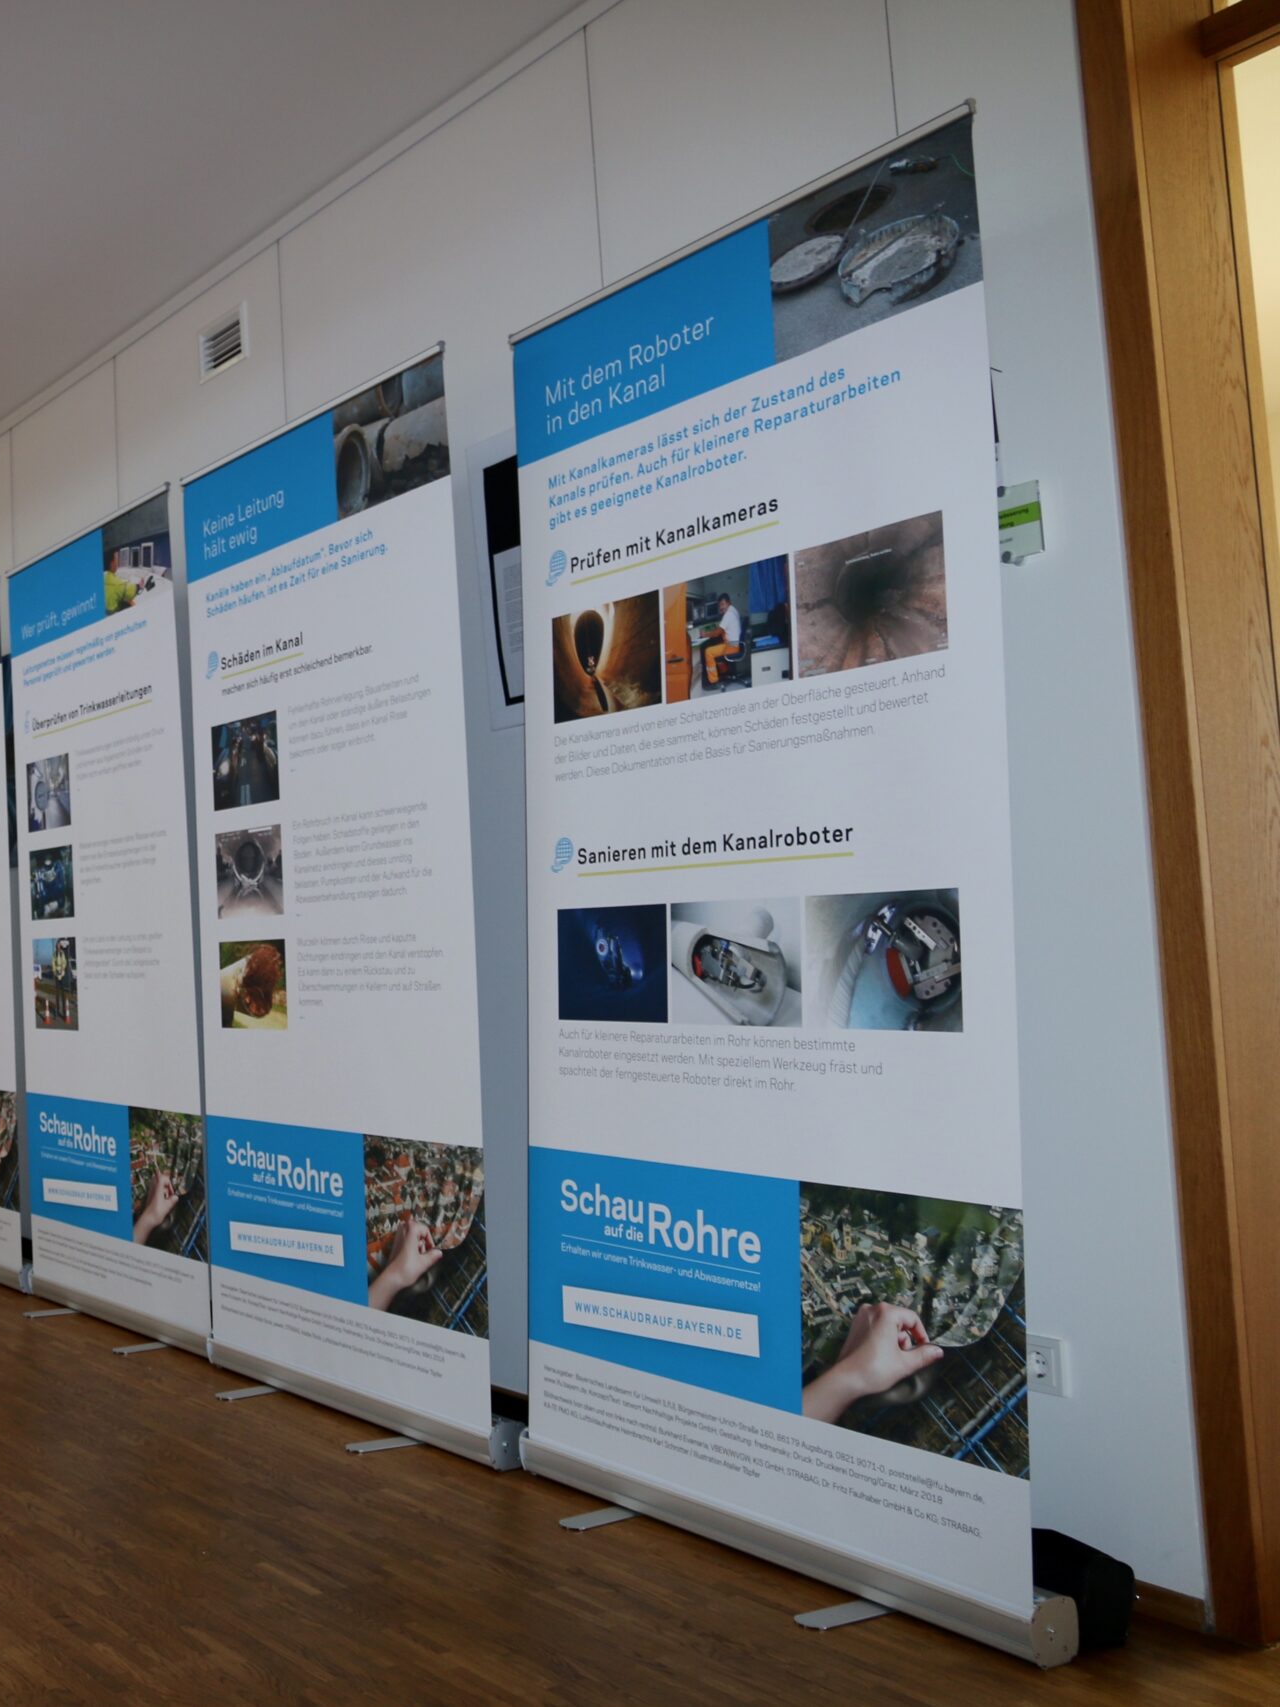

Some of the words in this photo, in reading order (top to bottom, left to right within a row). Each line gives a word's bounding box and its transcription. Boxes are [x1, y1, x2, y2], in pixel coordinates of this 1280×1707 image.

[544, 374, 576, 408] Mit
[580, 354, 622, 391] dem
[628, 311, 714, 371] Roboter
[546, 411, 562, 435] in
[567, 393, 602, 427] den
[608, 362, 666, 410] Kanal
[547, 472, 566, 490] Mit
[568, 439, 654, 483] Kanalkameras
[656, 424, 689, 449] lässt
[691, 412, 720, 436] sich
[722, 402, 747, 424] der
[750, 374, 815, 414] Zustand
[818, 364, 846, 389] des
[548, 484, 586, 509] Kanals
[588, 467, 633, 496] prüfen.
[636, 453, 668, 478] Auch
[670, 445, 690, 465] für
[693, 423, 750, 457] kleinere
[753, 366, 901, 435] Reparaturarbeiten
[202, 509, 235, 539] Keine
[237, 486, 285, 525] Leitung
[548, 508, 572, 531] gibt
[573, 505, 588, 519] es
[589, 480, 653, 517] geeignete
[655, 447, 747, 491] Kanalroboter.
[203, 535, 227, 561] hält
[227, 522, 258, 552] ewig
[570, 544, 621, 574] Prüfen
[625, 534, 651, 558] mit
[655, 494, 778, 548] Kanalkameras
[220, 647, 261, 671] Schäden
[262, 642, 274, 657] im
[275, 631, 303, 653] Kanal
[31, 709, 67, 733] Überprüfen
[67, 708, 79, 720] von
[78, 680, 153, 717] Trinkwasserleitungen
[577, 843, 646, 865] Sanieren
[650, 838, 677, 859] mit
[681, 835, 717, 856] dem
[722, 823, 854, 852] Kanalroboter
[557, 1027, 580, 1040] Auch
[580, 1027, 593, 1041] für
[594, 1029, 628, 1042] kleinere
[629, 1030, 712, 1046] Reparaturarbeiten
[713, 1033, 726, 1047] im
[726, 1033, 752, 1048] Rohr
[752, 1035, 792, 1049] können
[792, 1036, 856, 1053] bestimmte
[558, 1045, 612, 1060] Kanalroboter
[612, 1048, 659, 1065] eingesetzt
[660, 1051, 696, 1065] werden.
[697, 1052, 715, 1067] Mit
[715, 1054, 771, 1070] speziellem
[771, 1056, 827, 1076] Werkzeug
[828, 1058, 858, 1074] fräst
[860, 1061, 884, 1076] und
[558, 1063, 598, 1079] spachtelt
[598, 1066, 614, 1079] der
[614, 1066, 681, 1085] ferngesteuerte
[681, 1070, 722, 1087] Roboter
[722, 1074, 753, 1089] direkt
[753, 1077, 768, 1089] im
[38, 1110, 74, 1138] Schau
[72, 1122, 117, 1157] Rohre
[225, 1138, 276, 1172] Schau
[276, 1153, 344, 1198] Rohre
[560, 1177, 644, 1225] Schau
[647, 1201, 762, 1265] Rohre
[603, 1221, 624, 1239] auf
[624, 1224, 644, 1243] die
[574, 1299, 742, 1342] WWW.SCHAUDRAUF.BAYERN.DE
